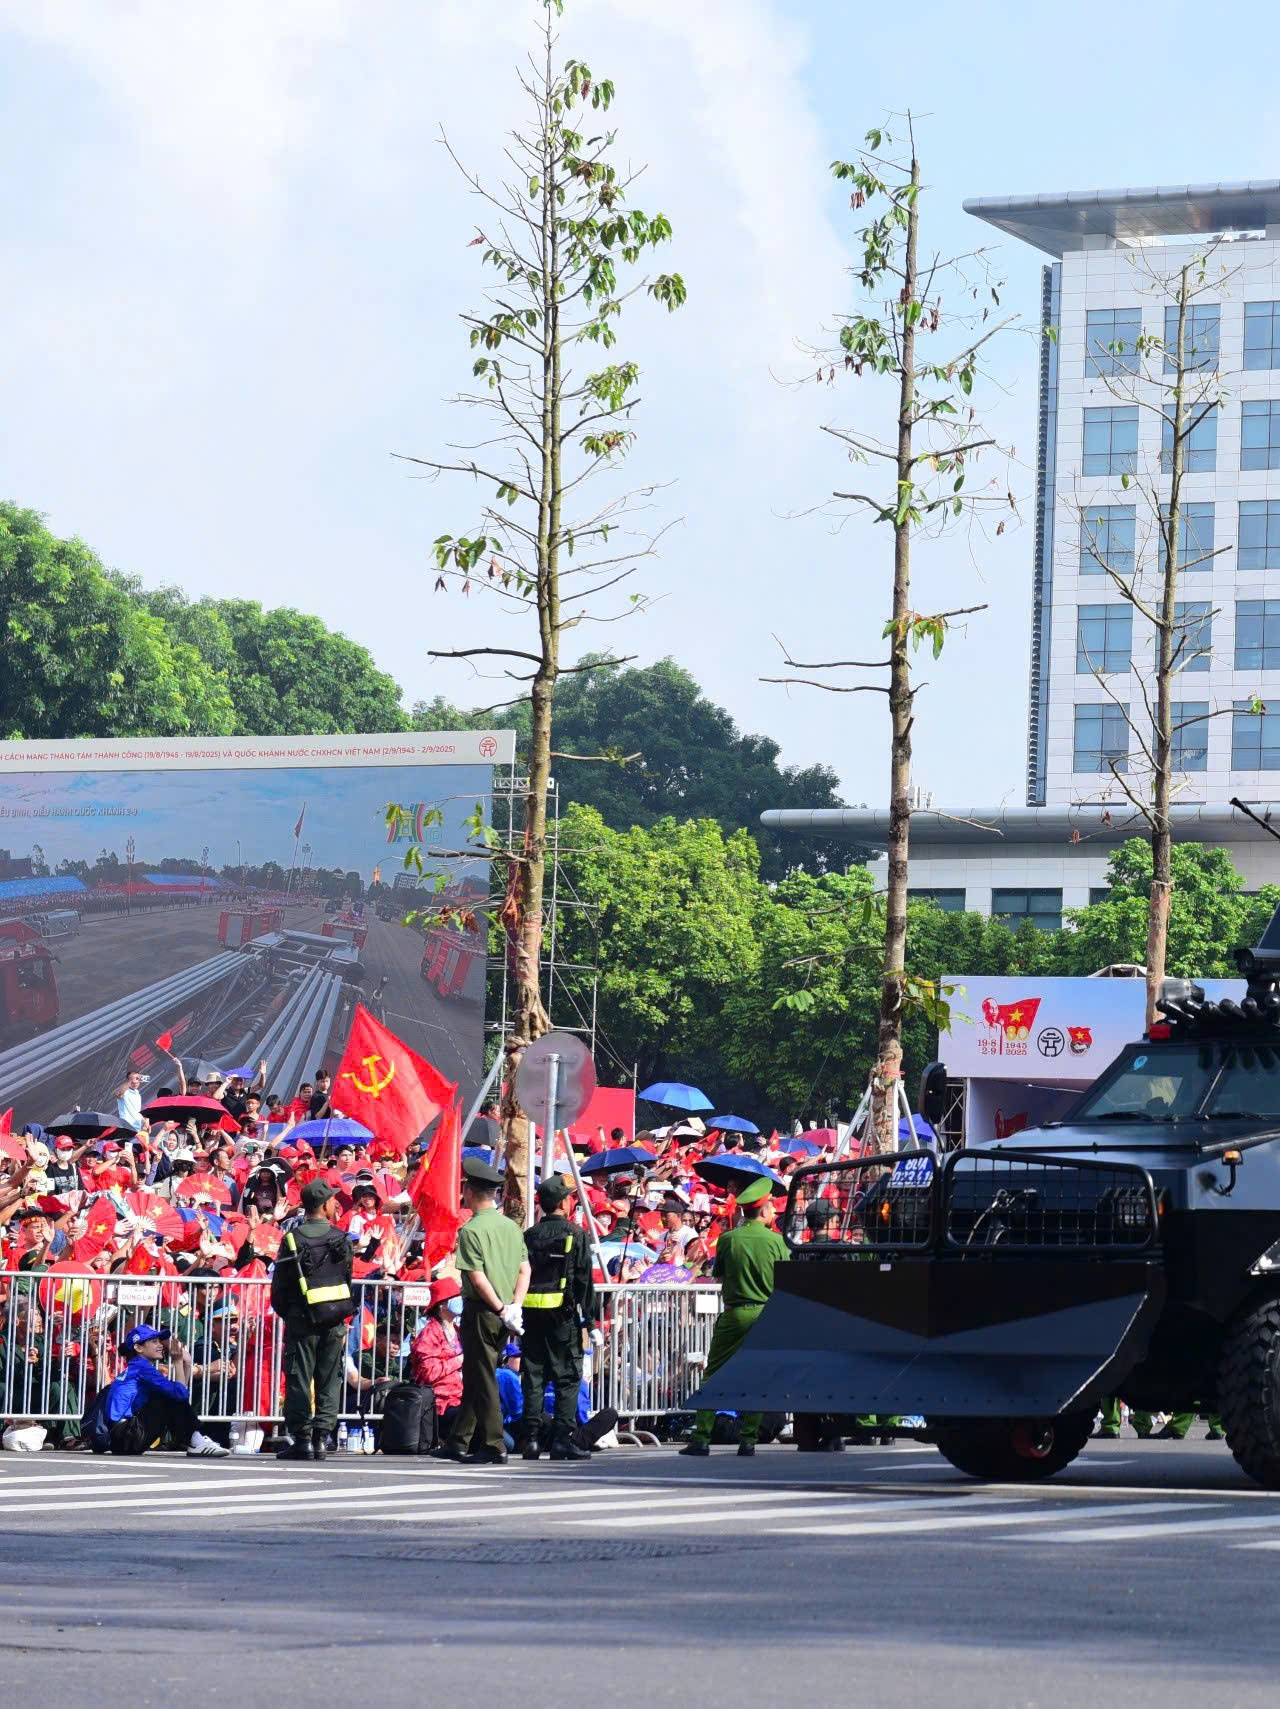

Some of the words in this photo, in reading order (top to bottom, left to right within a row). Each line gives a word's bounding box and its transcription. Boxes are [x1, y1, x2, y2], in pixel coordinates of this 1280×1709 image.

[5, 751, 24, 760] CÁCH
[50, 751, 75, 760] THÁNG
[77, 750, 92, 760] TÁM
[235, 748, 257, 758] QUỐC
[259, 748, 285, 757] KHÁNH
[288, 747, 309, 757] NƯỚC
[311, 748, 343, 757] CHXHCN
[363, 747, 380, 756] NAM
[382, 746, 416, 756] (2/9/1945
[422, 744, 456, 754] 2/9/2025)
